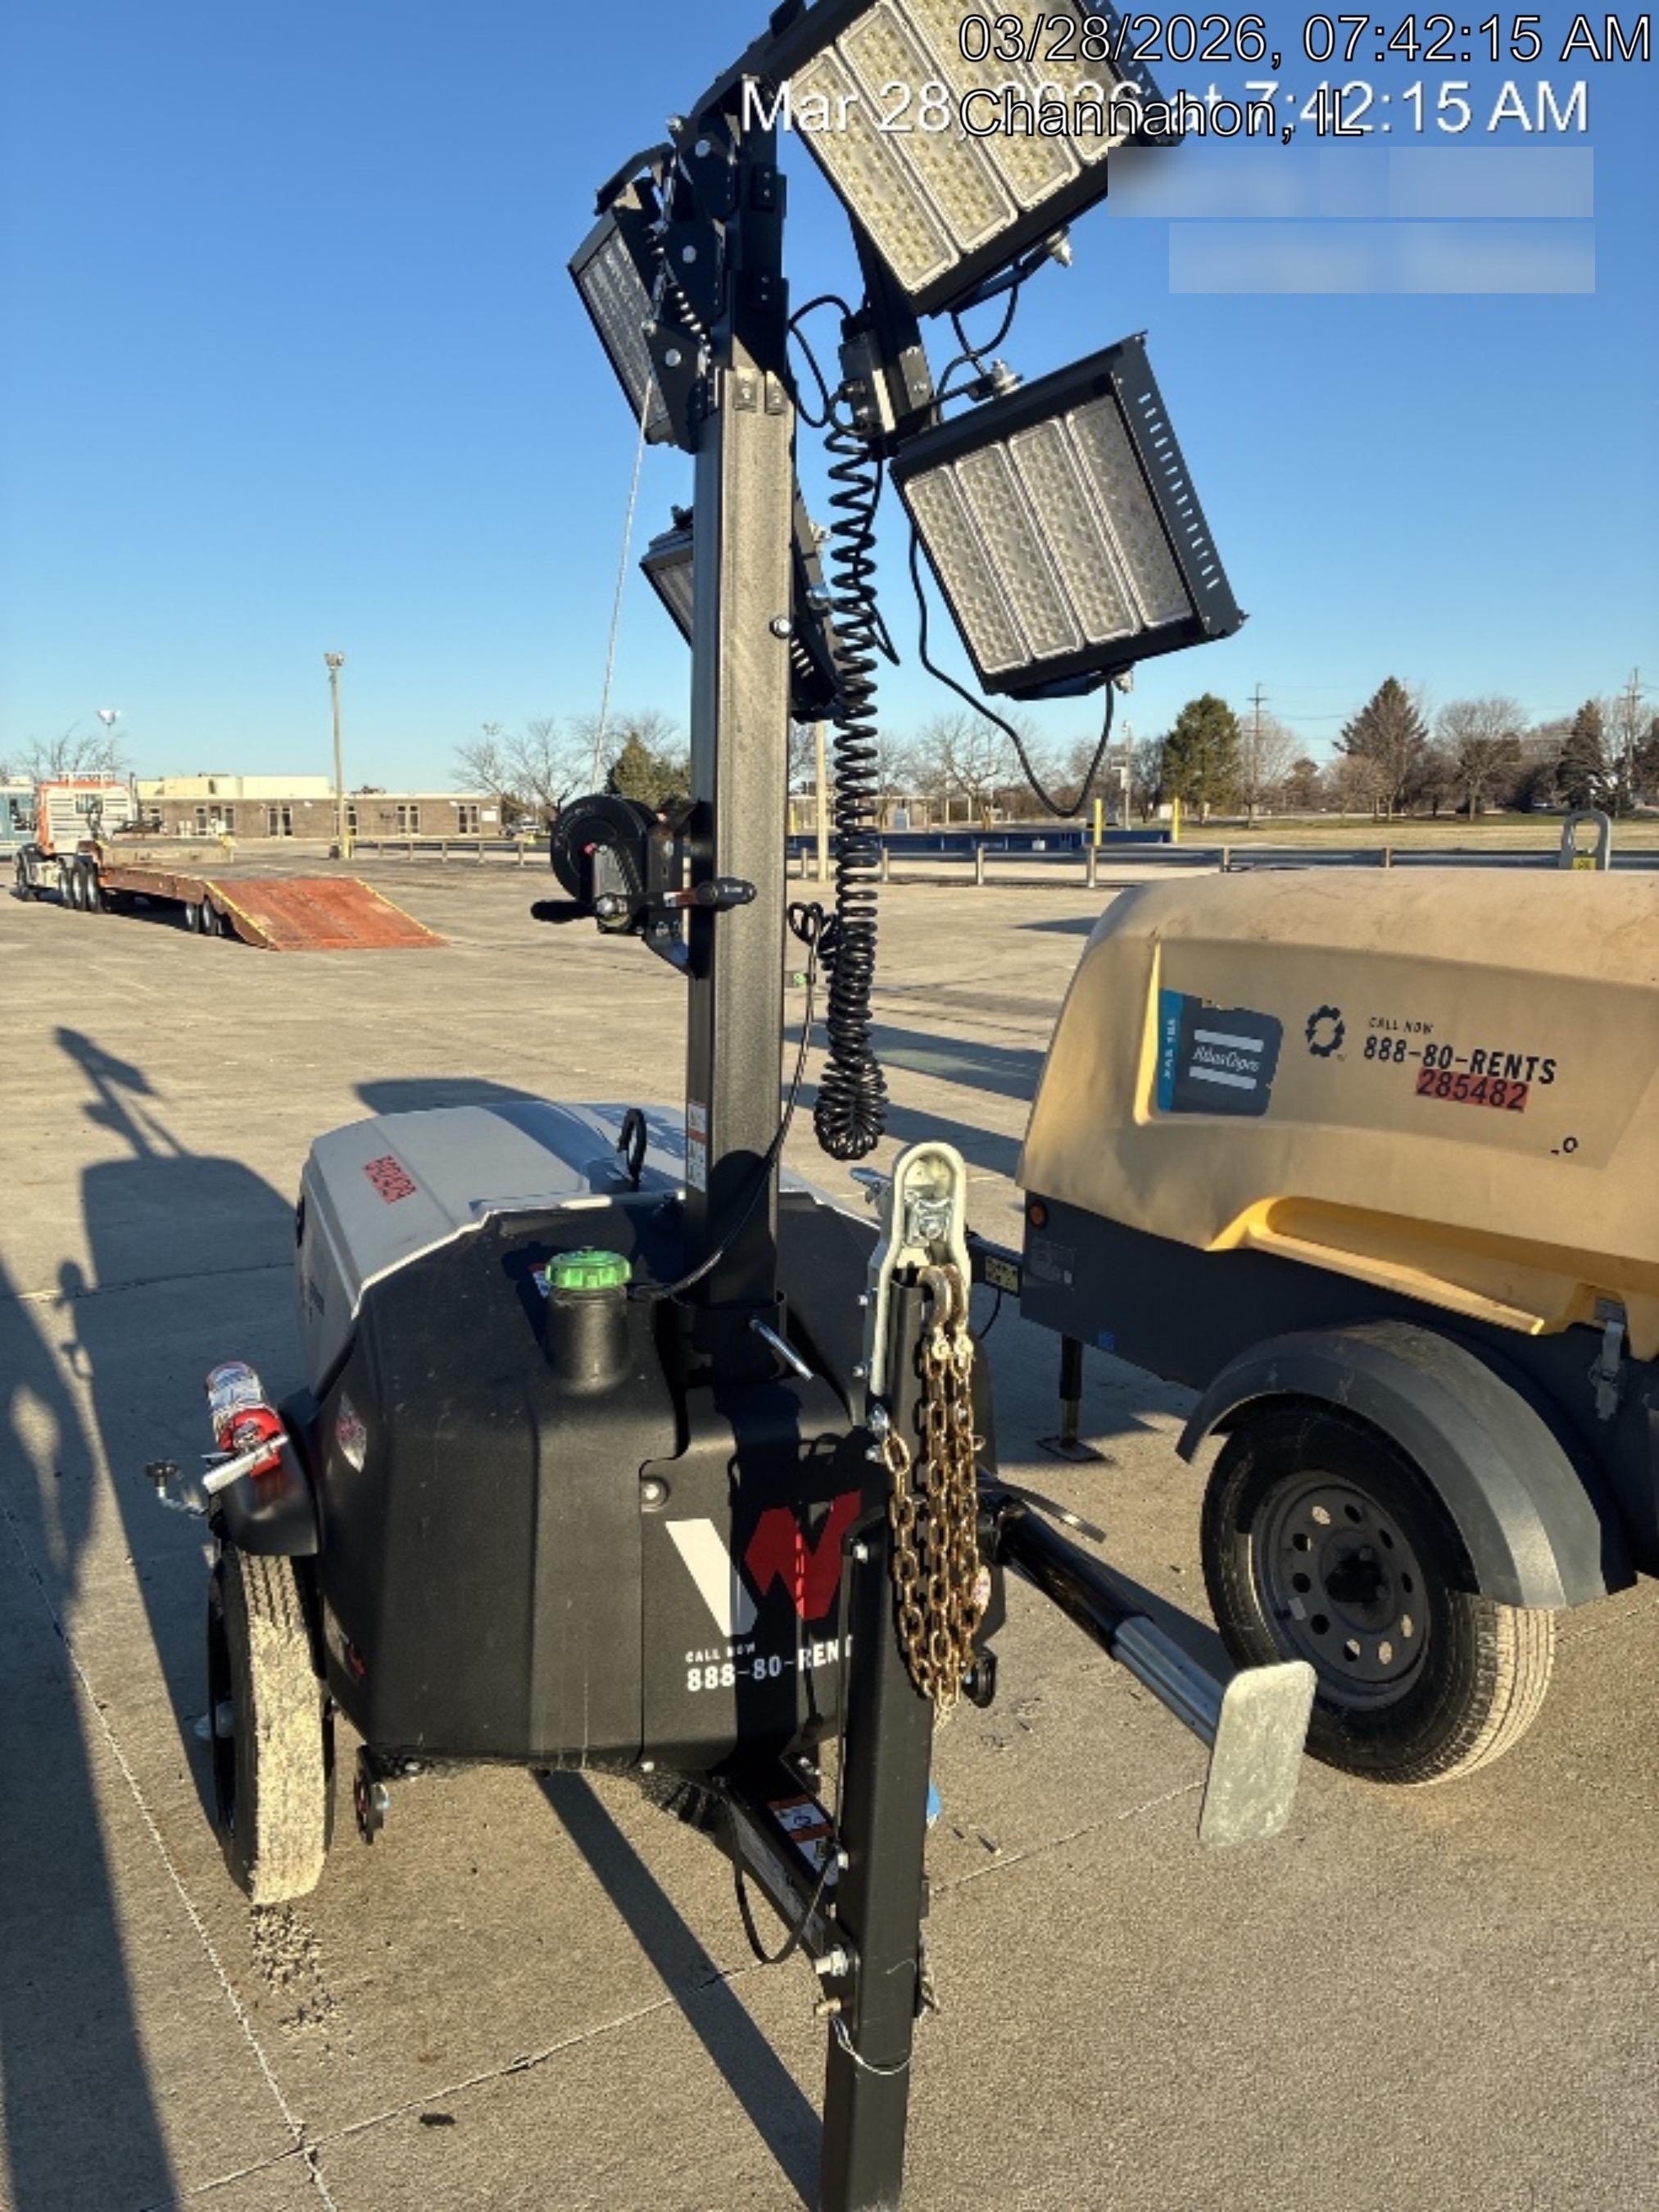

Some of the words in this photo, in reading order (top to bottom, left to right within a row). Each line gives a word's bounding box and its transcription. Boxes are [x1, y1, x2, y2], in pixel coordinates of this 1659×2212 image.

[1369, 1017, 1398, 1031] CALL
[1404, 1020, 1434, 1034] NOW
[1363, 1036, 1557, 1085] 888-80-RENTS
[1416, 1068, 1528, 1112] 285482
[685, 1646, 721, 1663] CALL
[727, 1642, 755, 1658] NOW
